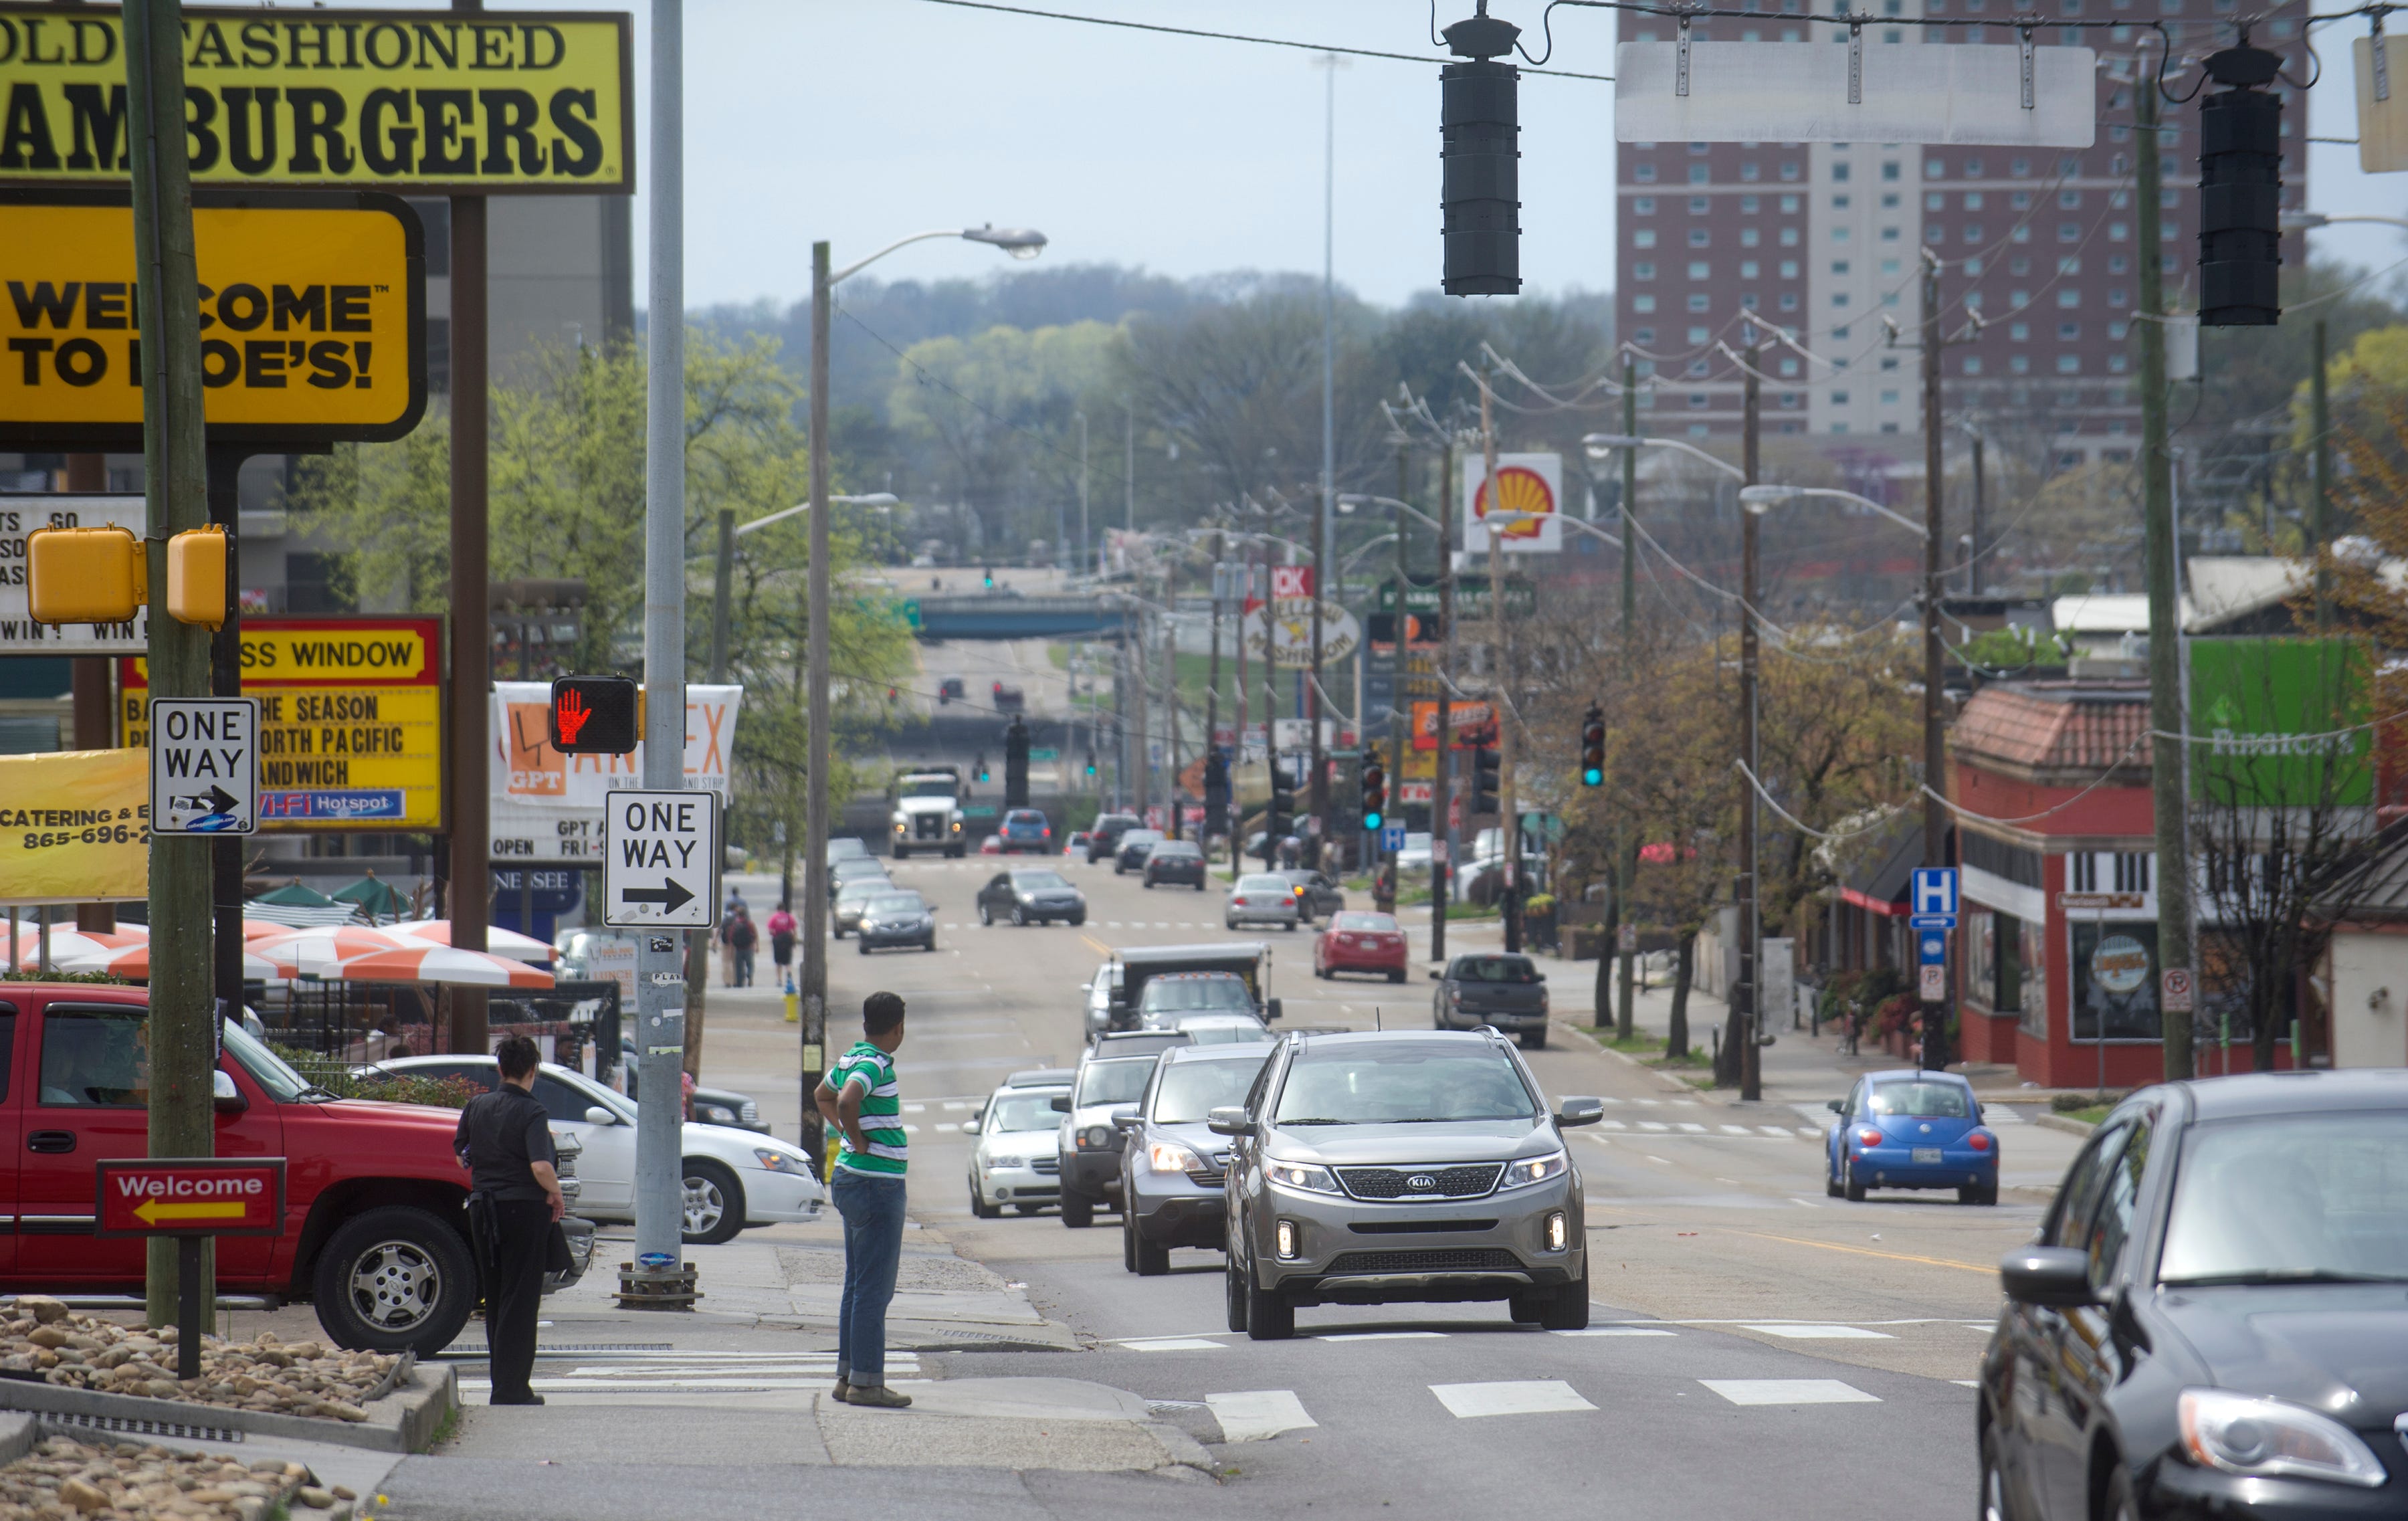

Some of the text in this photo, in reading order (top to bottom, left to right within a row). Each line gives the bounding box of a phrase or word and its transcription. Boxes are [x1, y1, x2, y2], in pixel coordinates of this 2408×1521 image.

[181, 19, 567, 70] ASHIONED
[0, 82, 604, 177] AMBURGERS
[8, 338, 373, 389] TO OE'S!
[291, 641, 413, 668] WINDOW
[296, 696, 379, 723] SEASON
[167, 710, 241, 741] ONE
[260, 726, 404, 756] ORTH PACIFIC
[165, 748, 244, 778] WAY
[260, 760, 349, 786] ANDWICH
[510, 771, 562, 789] GPT
[609, 777, 620, 789] ON
[623, 777, 639, 789] THE
[702, 777, 724, 789] STRIP
[317, 795, 390, 811] Hotspot
[0, 809, 112, 827] CATERING
[117, 807, 132, 820] &
[558, 821, 589, 836] GPT
[625, 802, 696, 833] ONE
[494, 839, 534, 856] OPEN
[623, 839, 697, 869] WAY
[1917, 871, 1952, 912] H
[117, 1175, 263, 1197] Welcome
[1411, 1178, 1431, 1187] KIA
